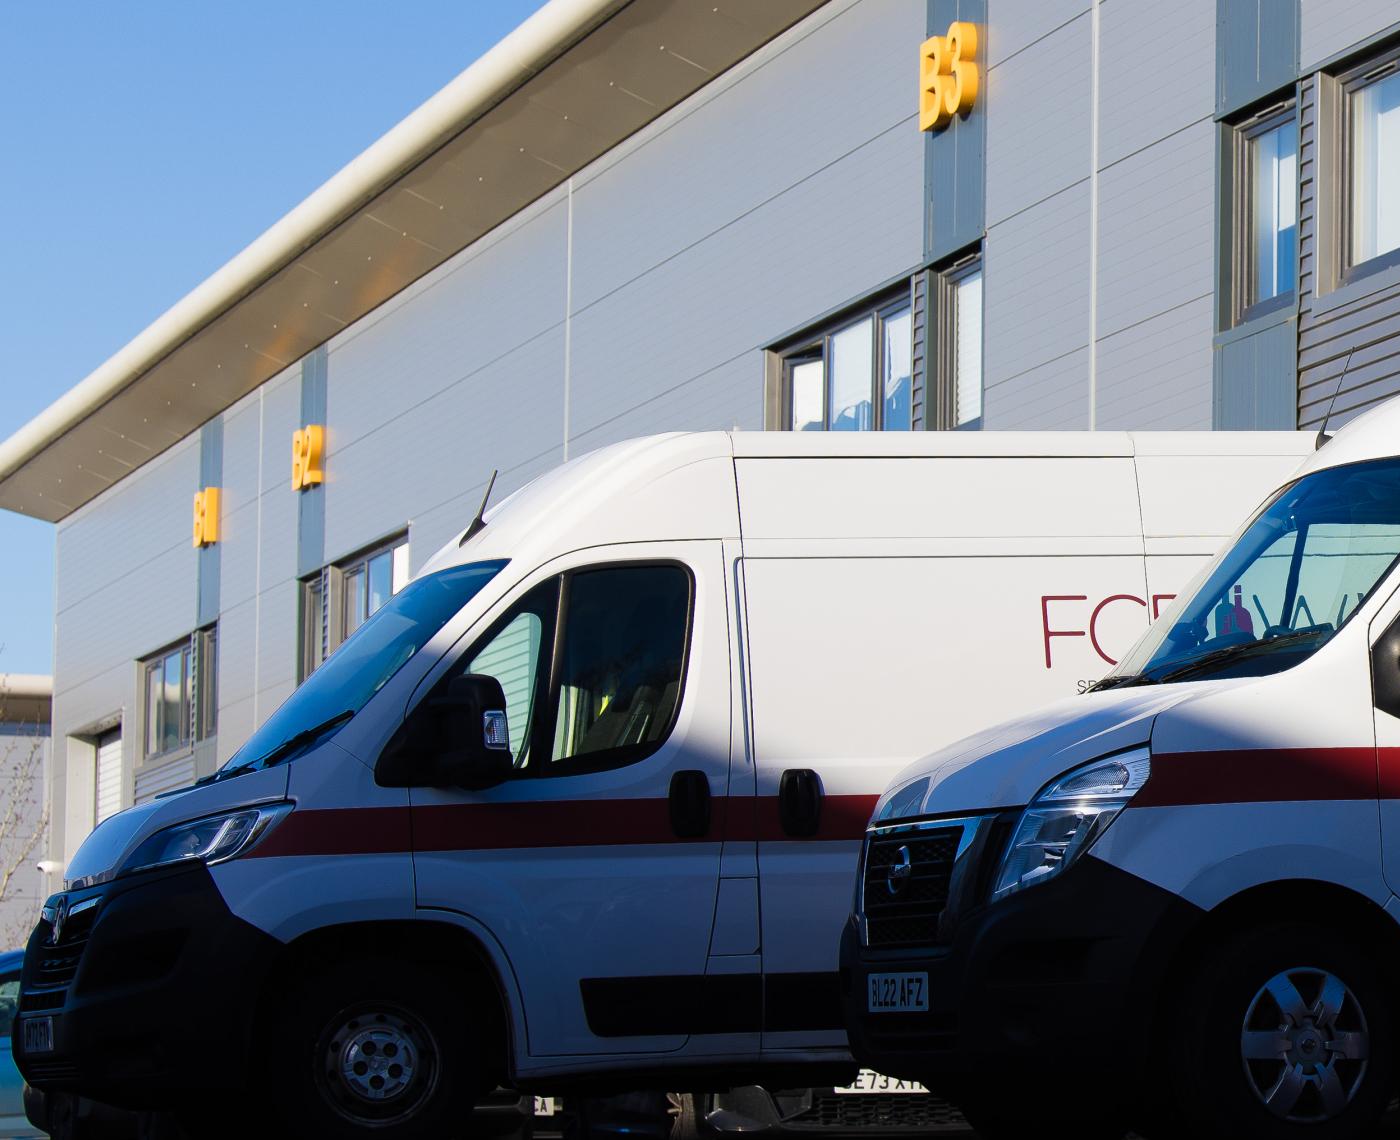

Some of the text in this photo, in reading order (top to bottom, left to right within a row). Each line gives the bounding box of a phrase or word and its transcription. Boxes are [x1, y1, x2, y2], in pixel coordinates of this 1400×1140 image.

[919, 21, 979, 132] B3
[292, 424, 324, 492] B2
[193, 487, 219, 549] B1
[871, 977, 924, 1007] BL22 AFZ
[844, 1072, 889, 1090] E73
